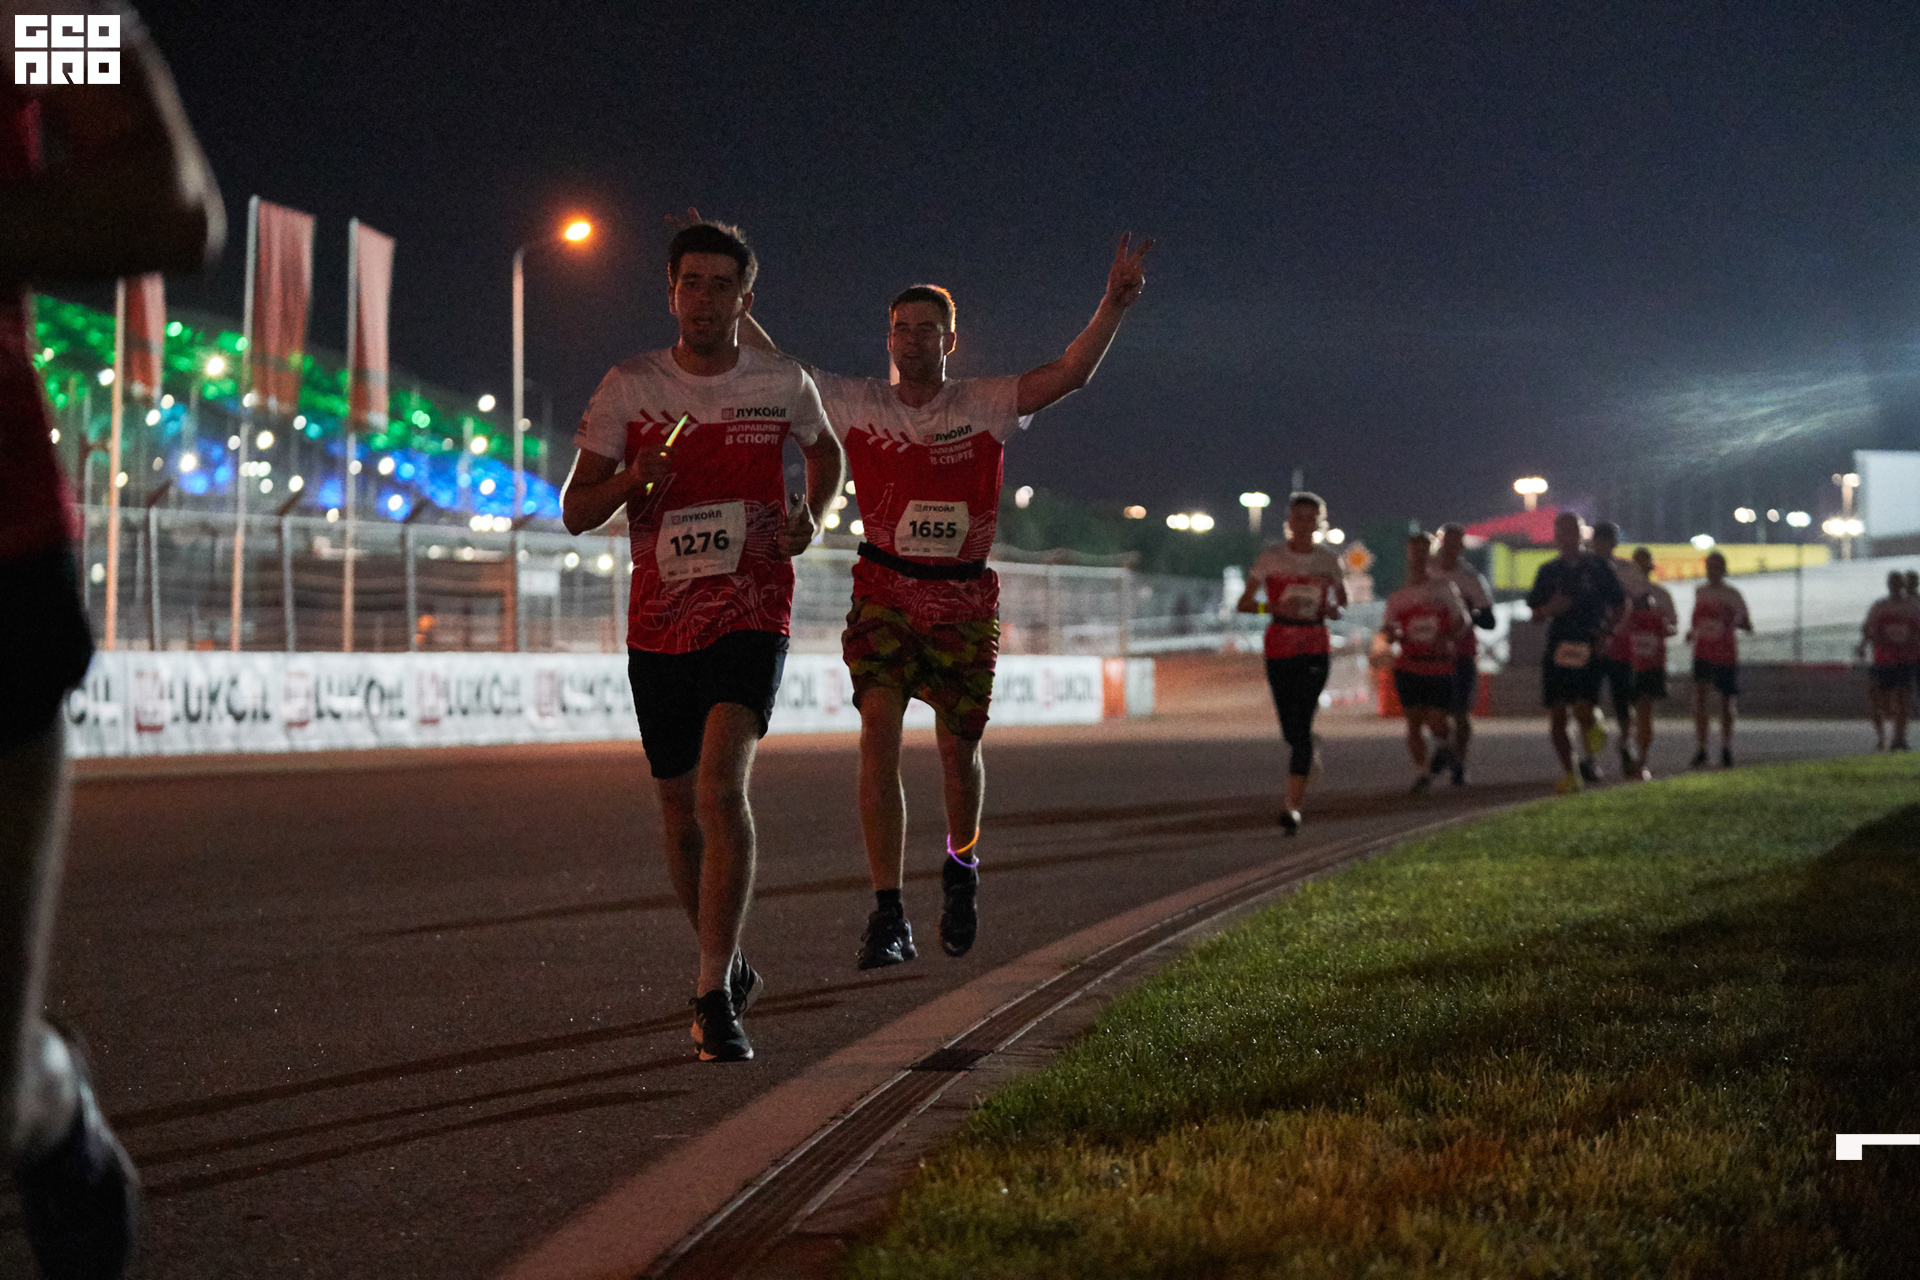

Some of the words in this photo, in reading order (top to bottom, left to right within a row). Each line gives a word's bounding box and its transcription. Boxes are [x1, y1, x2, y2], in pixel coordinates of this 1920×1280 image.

[736, 406, 786, 418] ЛУКОЙЛ
[725, 434, 734, 445] В
[923, 504, 955, 512] ЛУКОЙЛ
[681, 509, 722, 523] ЛУКОЙЛ
[909, 521, 957, 538] 1655
[670, 529, 730, 557] 1276
